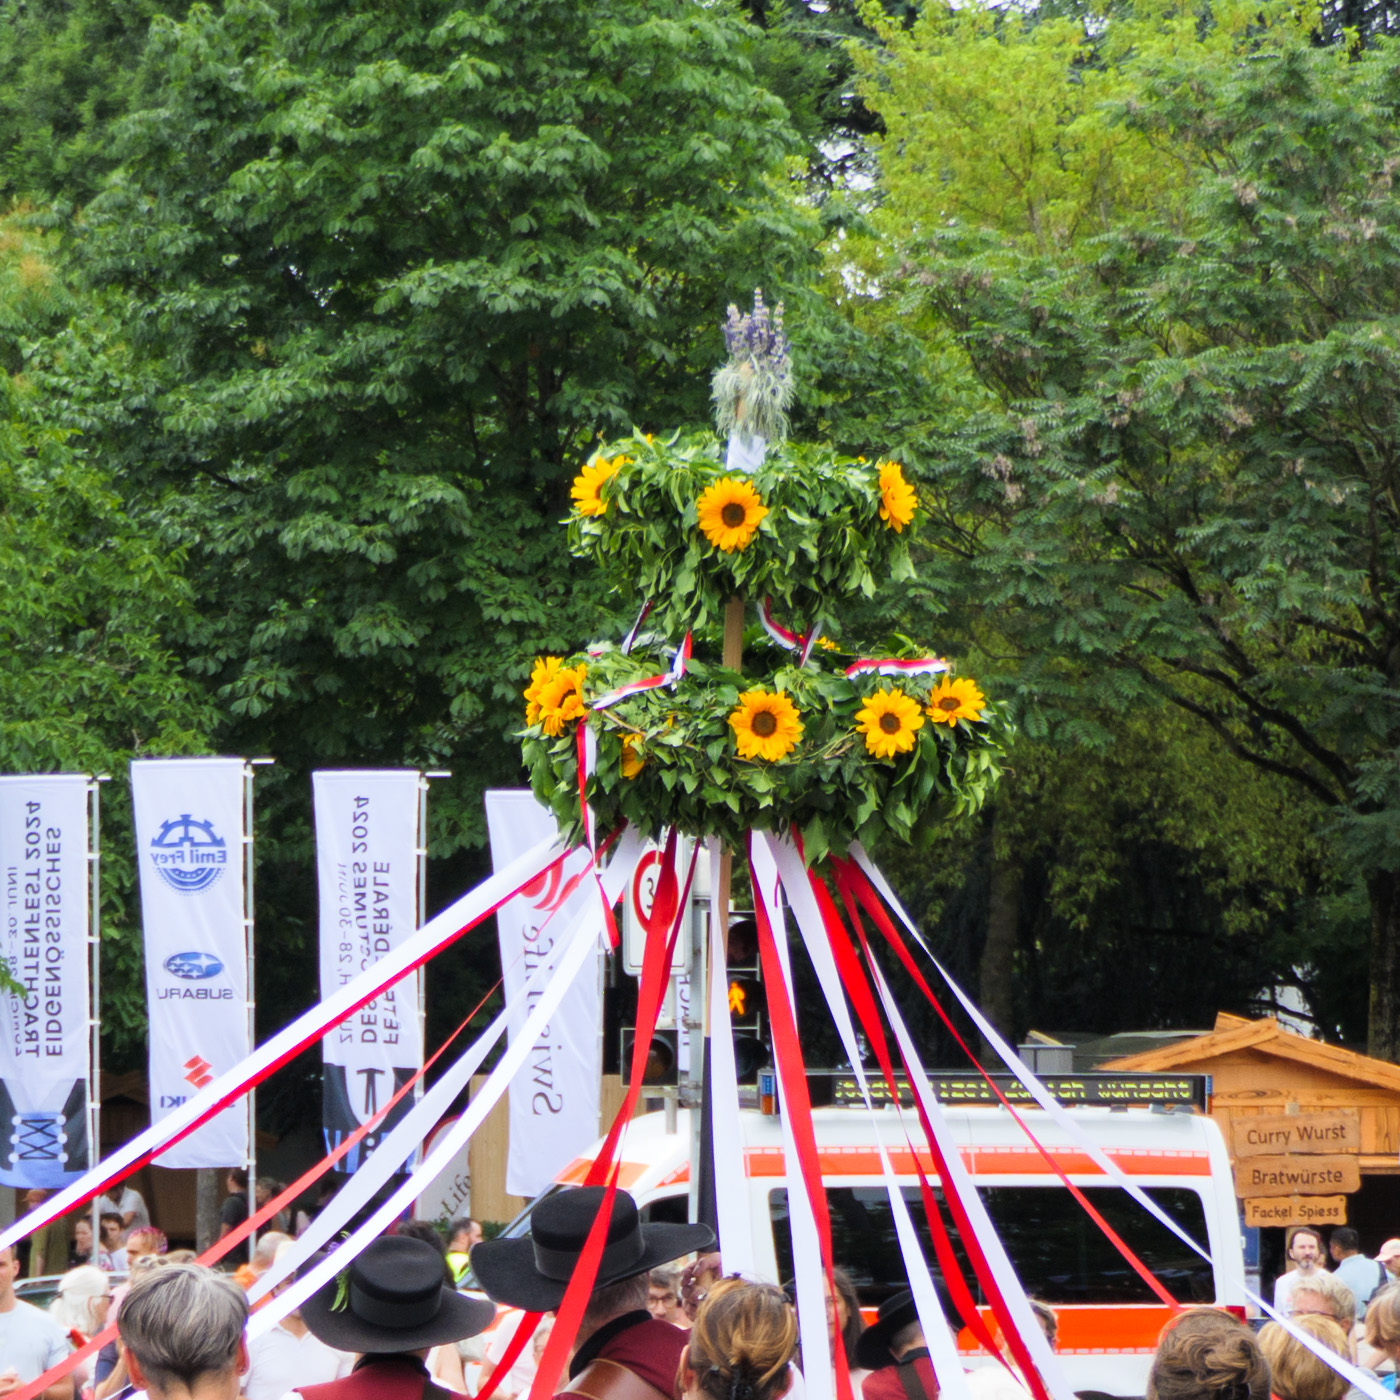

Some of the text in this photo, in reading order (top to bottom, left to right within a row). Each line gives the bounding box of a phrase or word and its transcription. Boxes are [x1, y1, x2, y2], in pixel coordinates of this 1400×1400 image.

[1247, 1125, 1347, 1147] Curry Wurst
[1252, 1167, 1343, 1187] Bratwürste
[1252, 1204, 1340, 1220] Fackel Spiess
